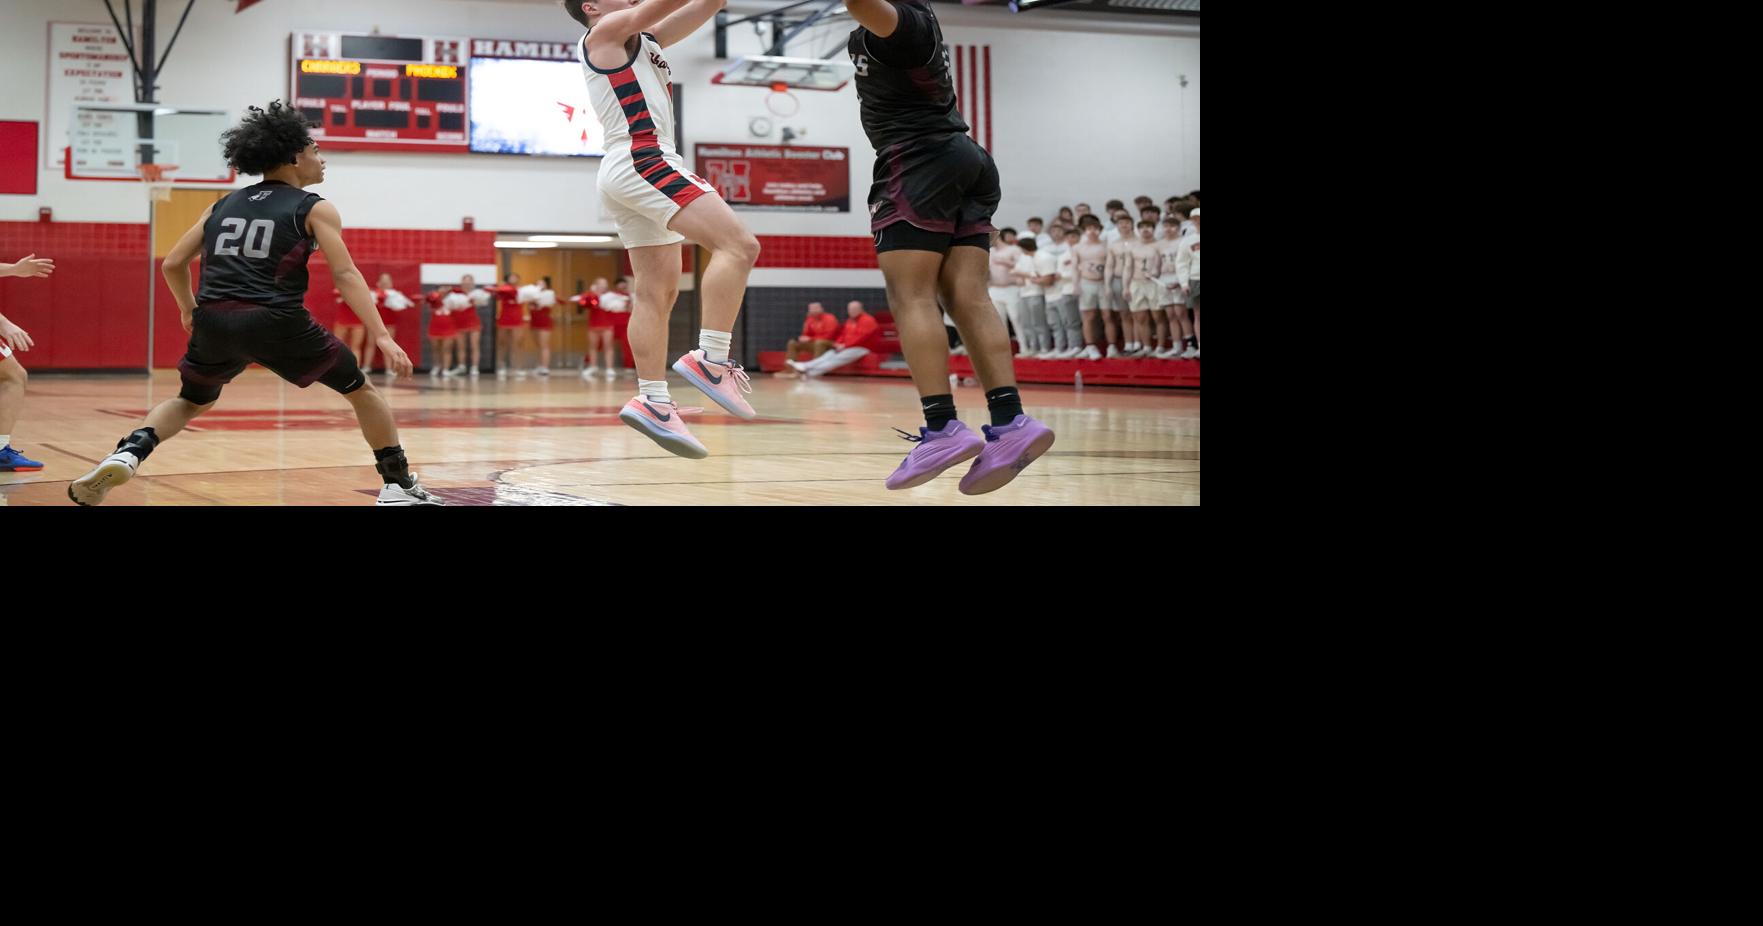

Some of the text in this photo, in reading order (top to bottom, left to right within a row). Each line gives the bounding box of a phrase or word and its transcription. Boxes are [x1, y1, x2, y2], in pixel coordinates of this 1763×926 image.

[72, 35, 117, 43] HAMILTON
[58, 52, 129, 61] SPORTSMANSHIP
[64, 69, 123, 78] EXPECTATION
[351, 100, 386, 111] PLAYER
[697, 147, 743, 158] Hamilton
[744, 148, 783, 159] Athletic
[822, 149, 845, 161] Club
[214, 217, 275, 259] 20
